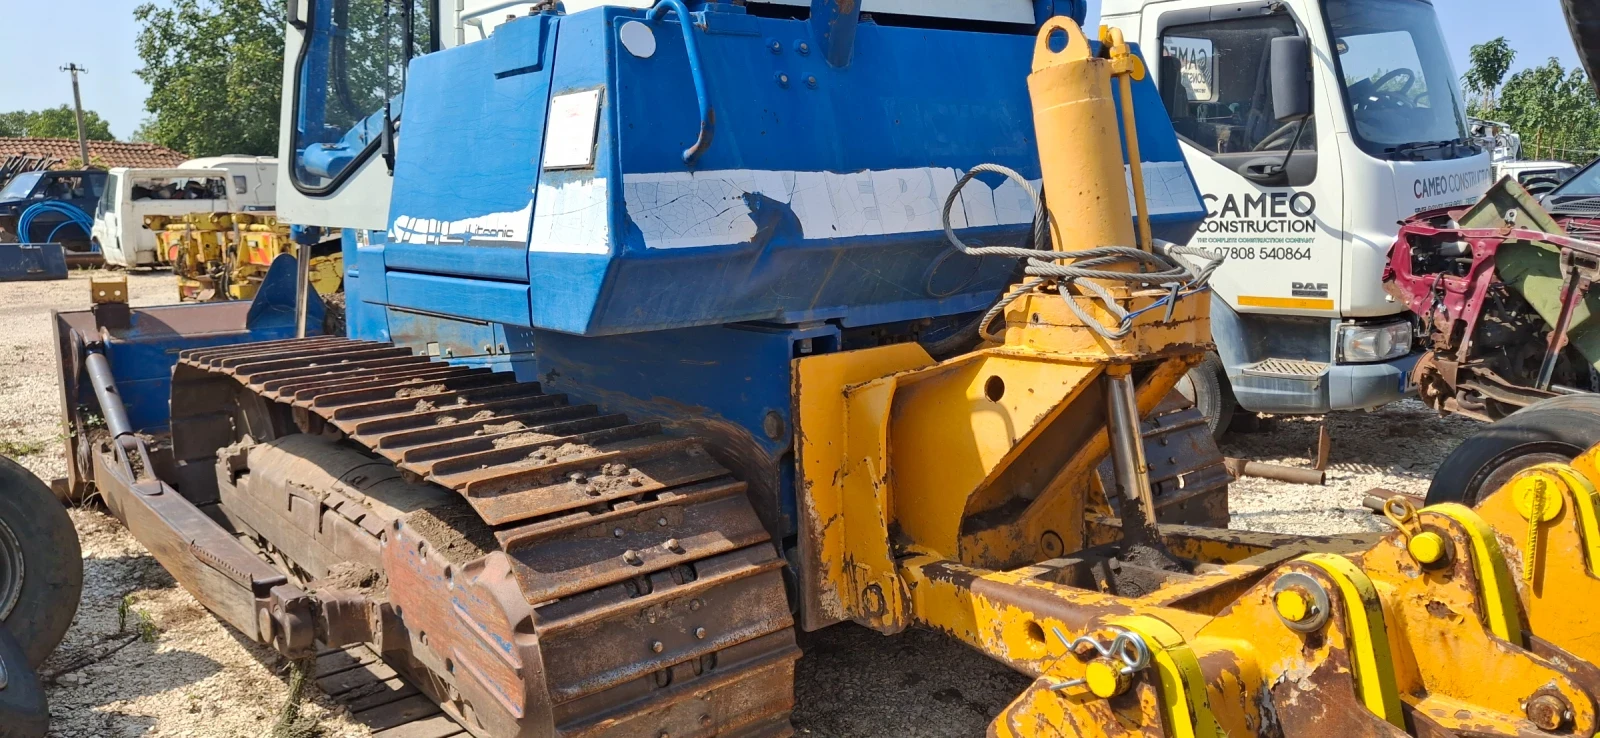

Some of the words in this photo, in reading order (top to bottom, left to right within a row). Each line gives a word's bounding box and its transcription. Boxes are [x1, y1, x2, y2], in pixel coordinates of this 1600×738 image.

[1414, 176, 1448, 199] CAMEO
[1202, 191, 1316, 219] CAMEO
[1197, 219, 1316, 233] CONSTRUCTION
[1214, 247, 1255, 260] 07808
[1259, 247, 1312, 260] 540864
[1291, 281, 1329, 290] DAF
